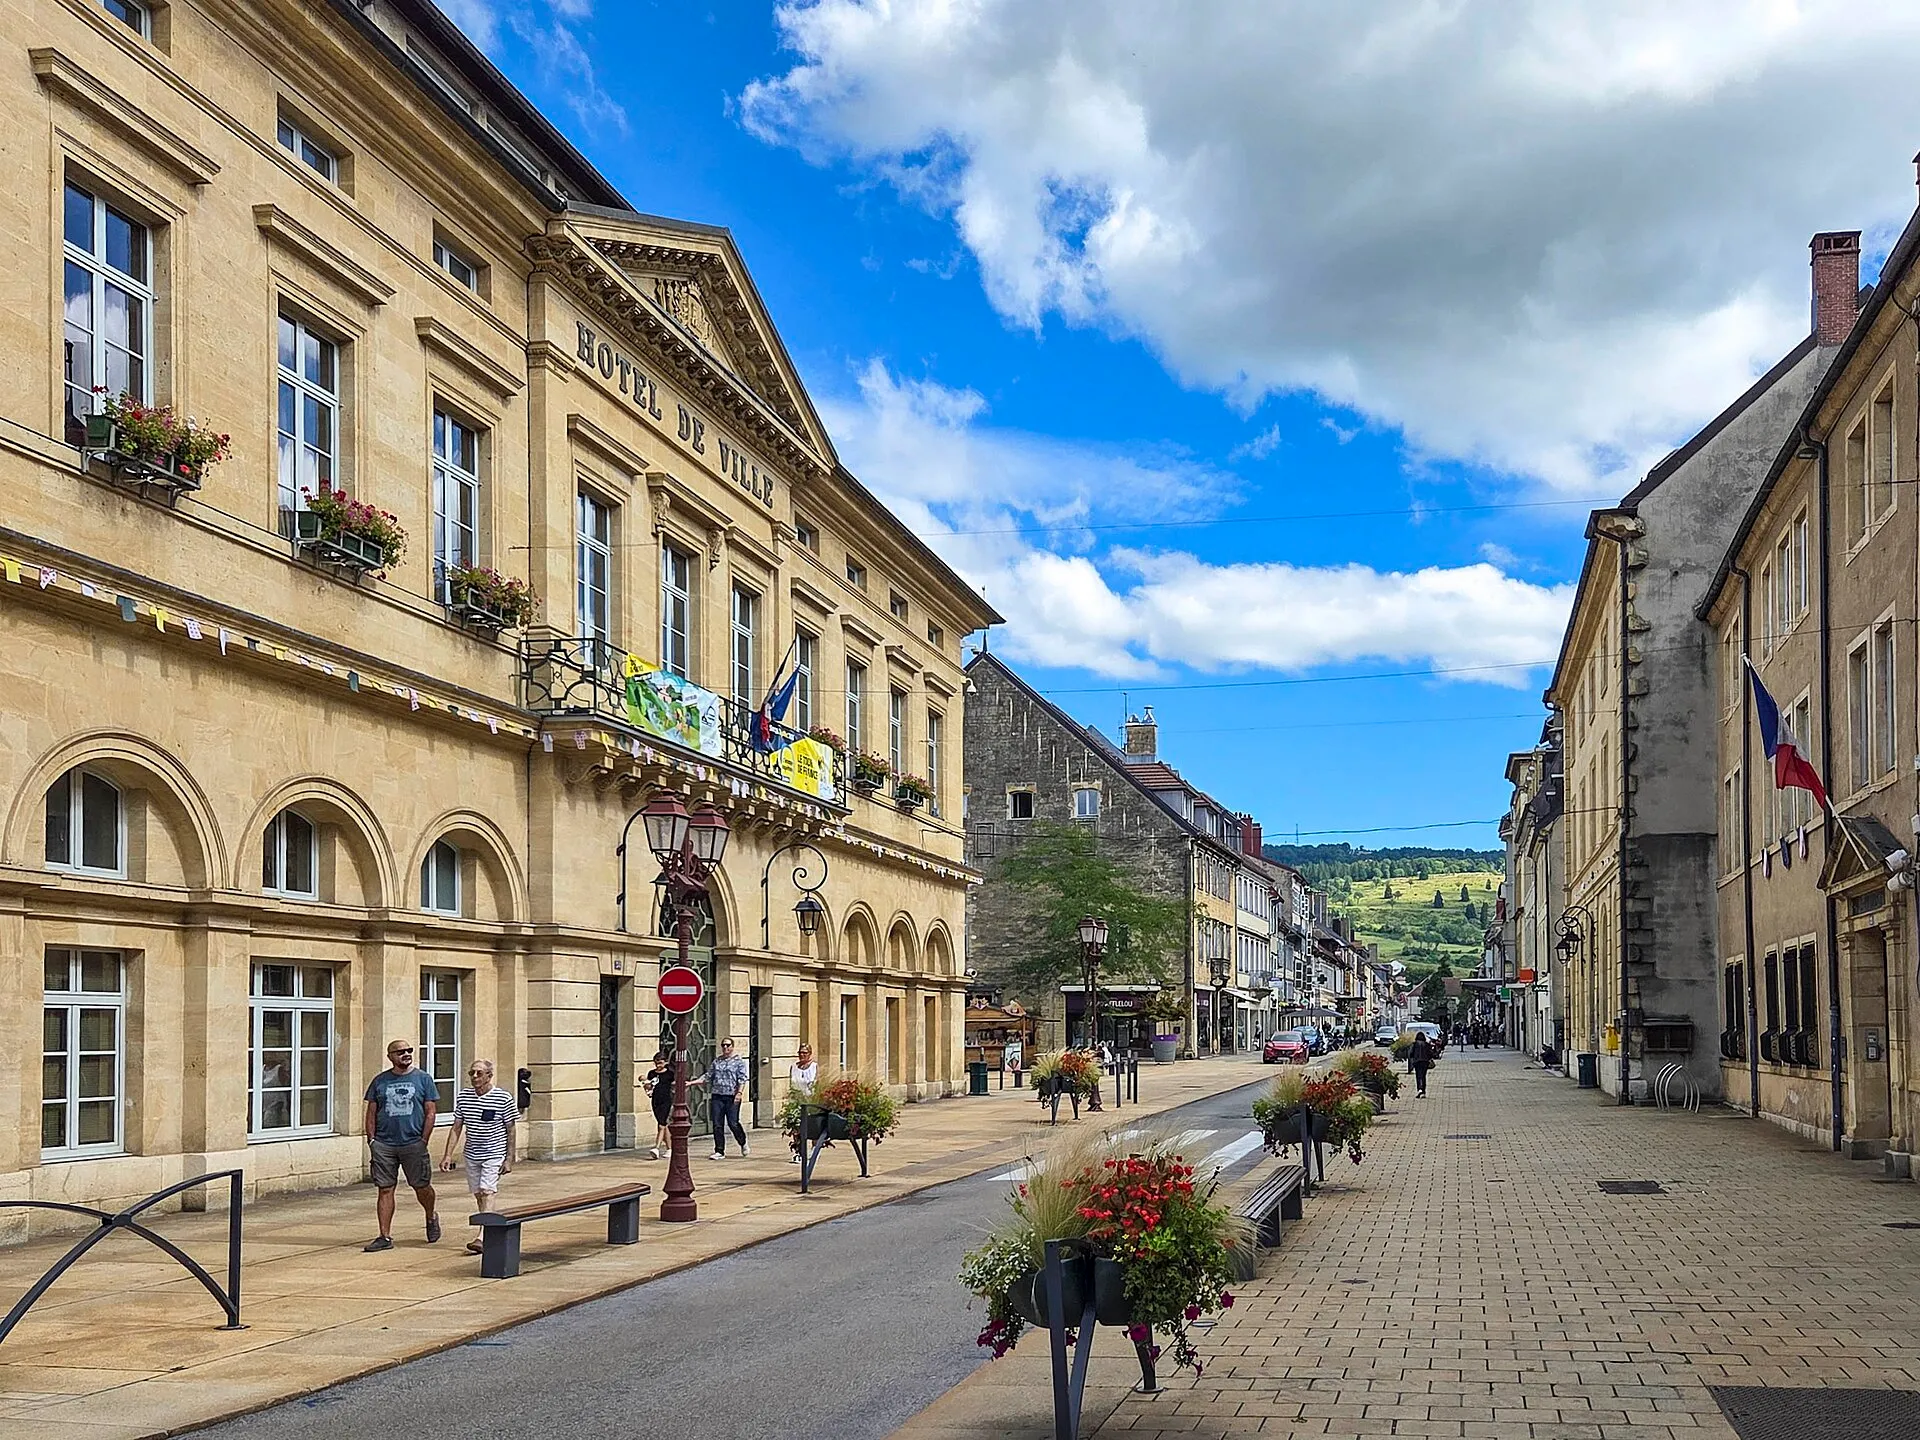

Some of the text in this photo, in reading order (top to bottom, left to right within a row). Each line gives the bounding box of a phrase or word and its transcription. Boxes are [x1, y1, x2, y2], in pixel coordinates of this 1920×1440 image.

[576, 320, 773, 509] HOTEL DE VILLE
